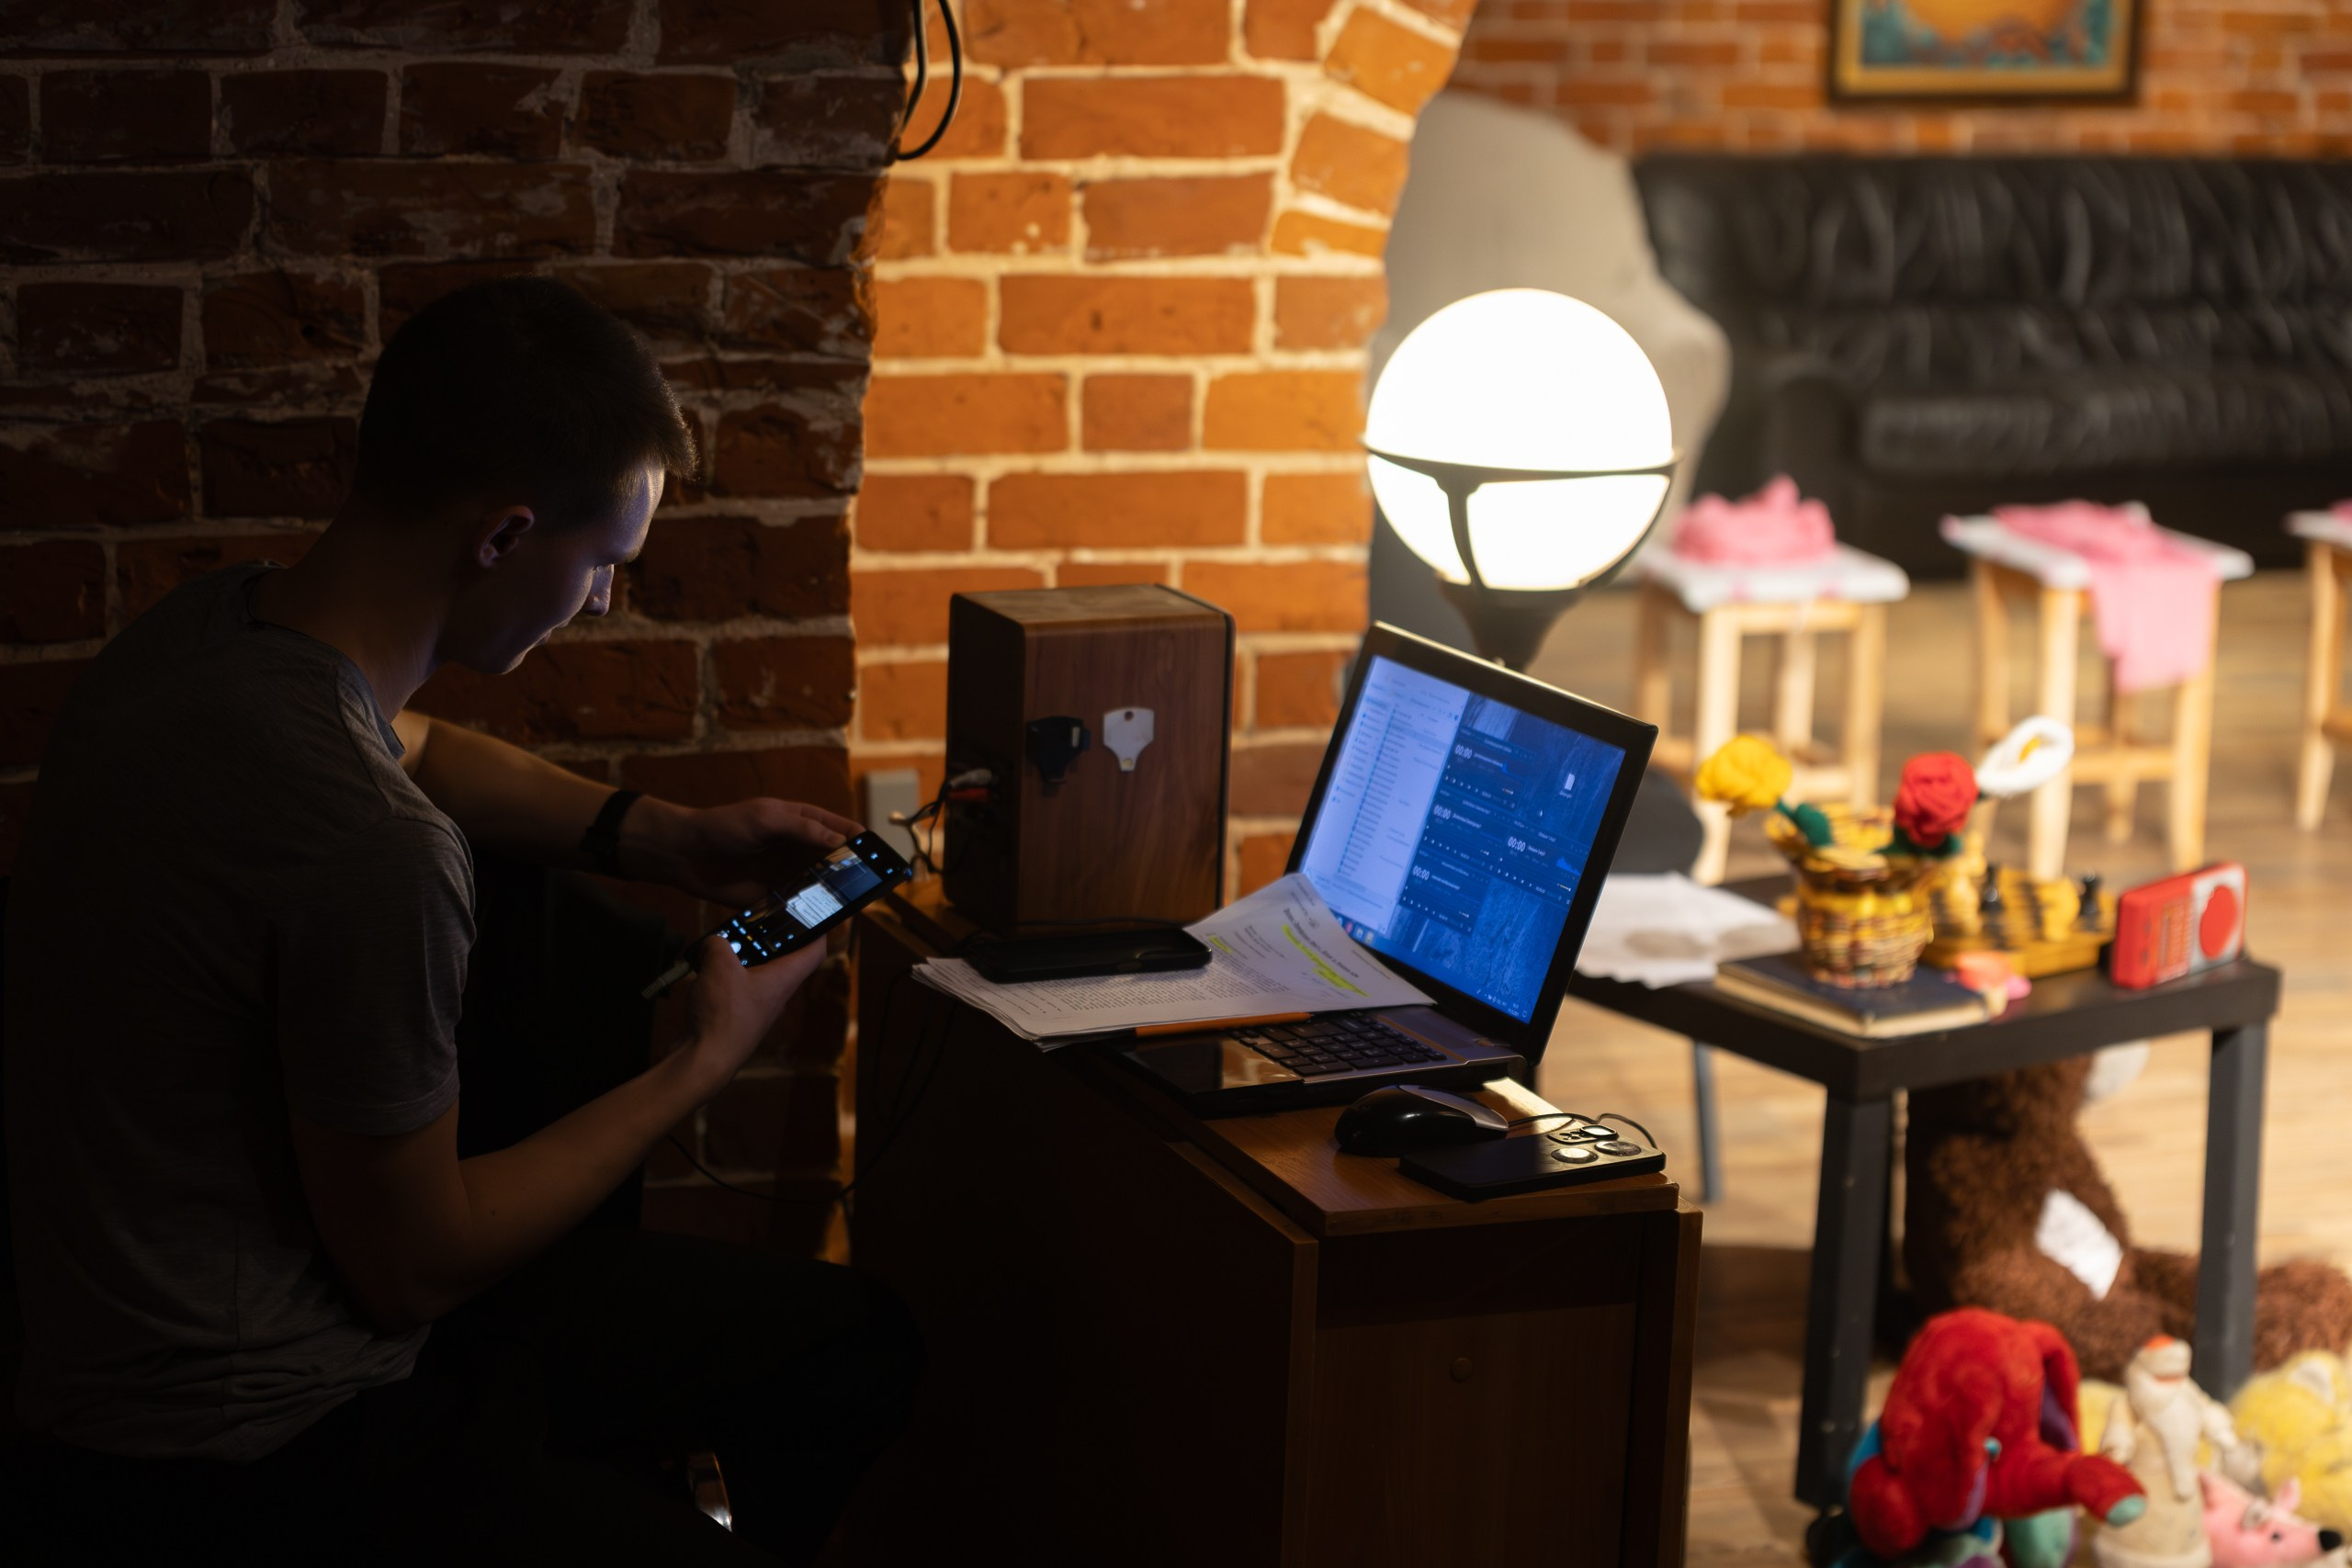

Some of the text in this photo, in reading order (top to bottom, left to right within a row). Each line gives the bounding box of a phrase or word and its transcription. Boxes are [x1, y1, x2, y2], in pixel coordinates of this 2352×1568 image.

[1455, 744, 1472, 759] 00:00
[1434, 805, 1452, 820] 00:00
[1508, 837, 1526, 852] 00:00
[1413, 865, 1430, 881] 00:00
